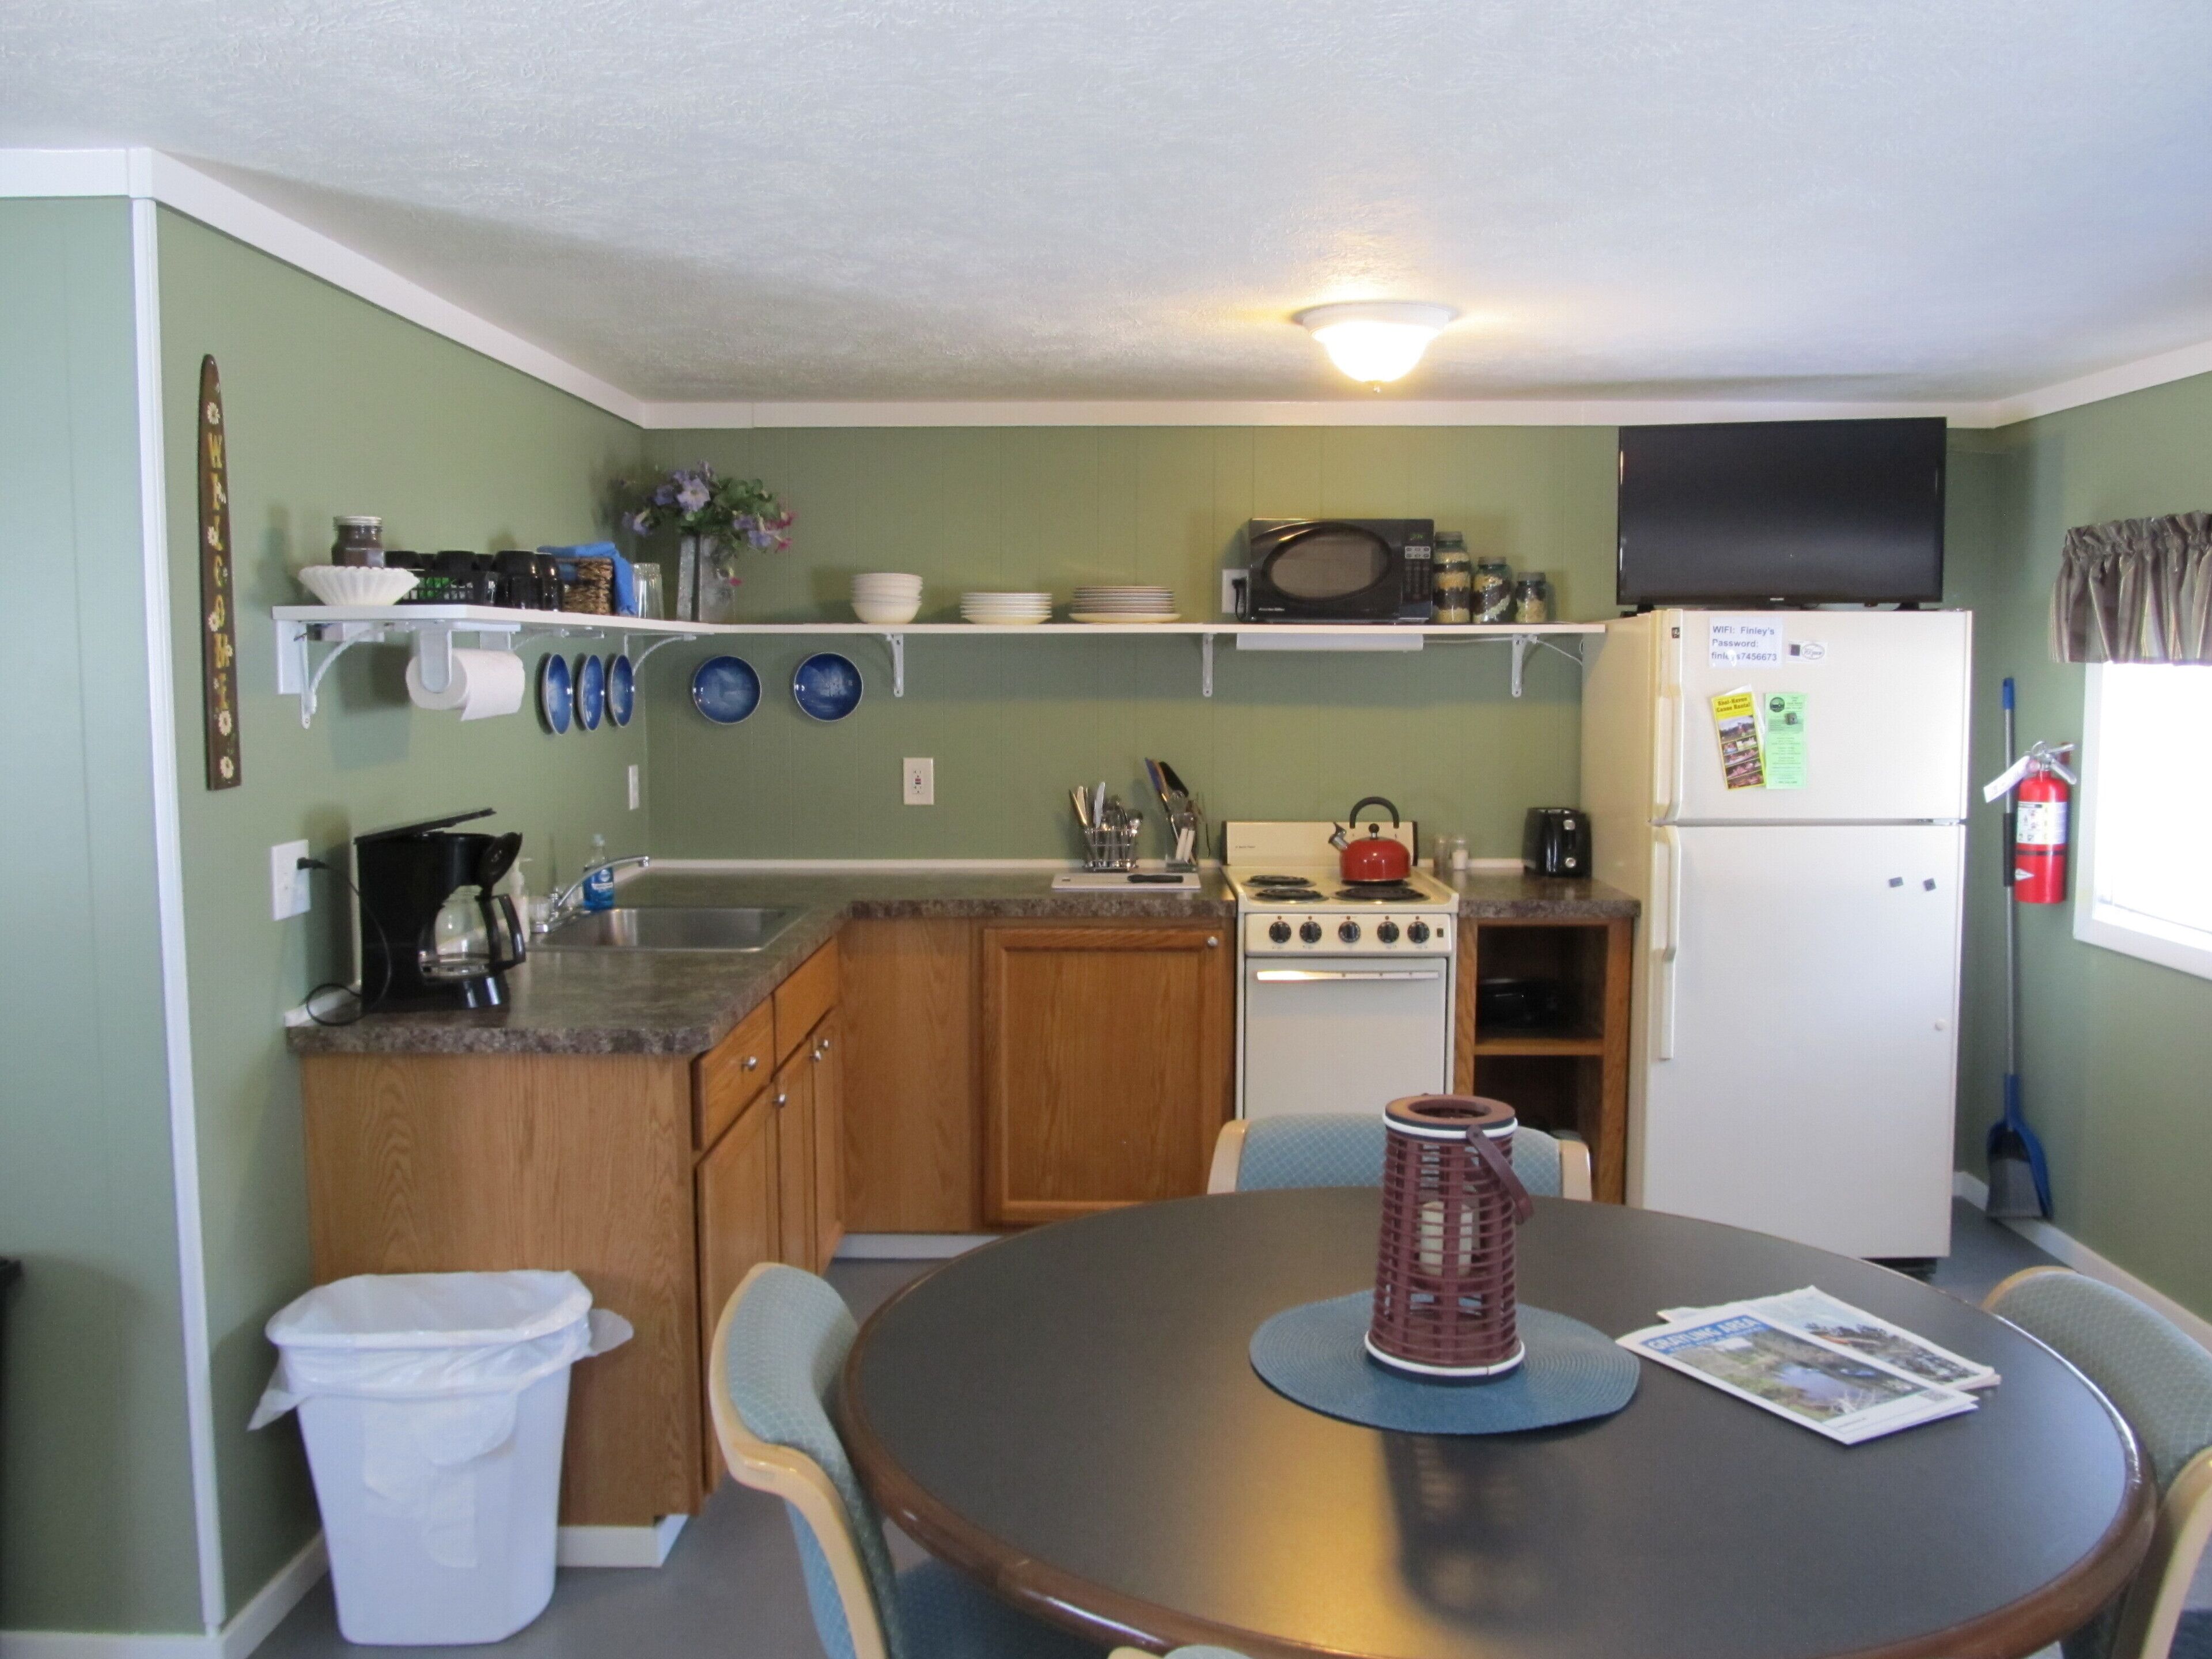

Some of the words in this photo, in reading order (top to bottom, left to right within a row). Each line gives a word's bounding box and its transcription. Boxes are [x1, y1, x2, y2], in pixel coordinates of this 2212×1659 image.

[1713, 626, 1735, 634] WIFI:
[1740, 626, 1775, 637] Finley's
[1712, 639, 1759, 647] Password:
